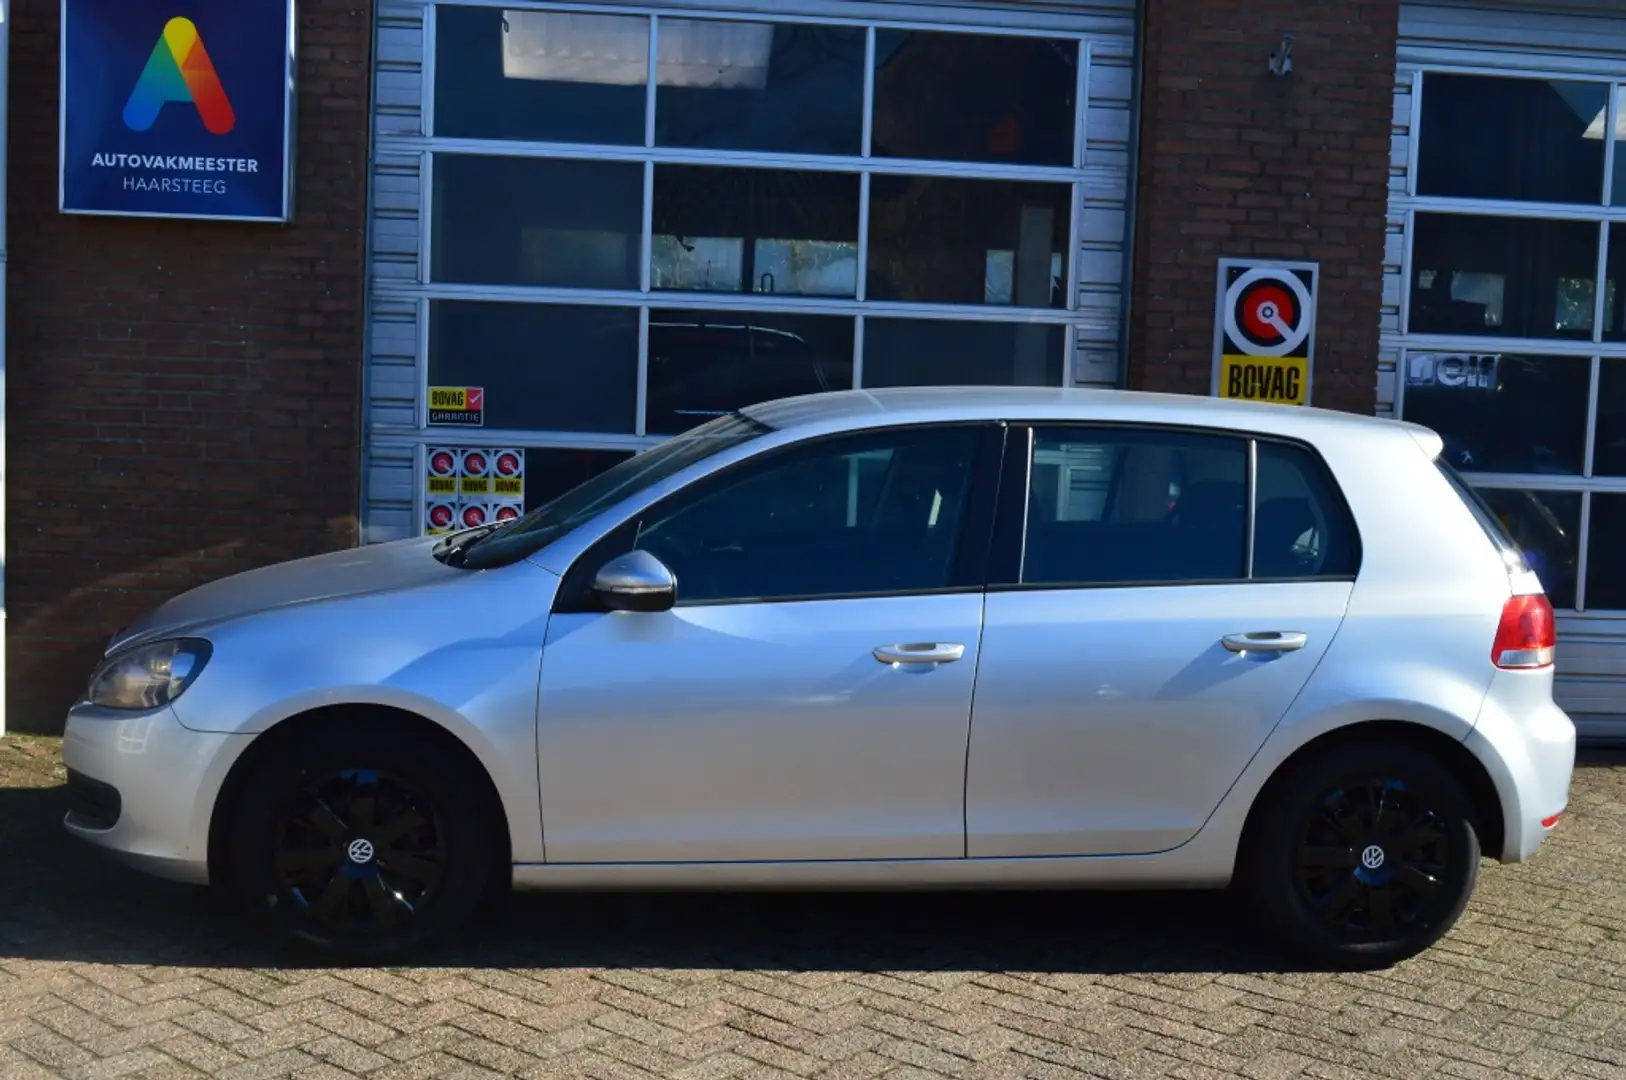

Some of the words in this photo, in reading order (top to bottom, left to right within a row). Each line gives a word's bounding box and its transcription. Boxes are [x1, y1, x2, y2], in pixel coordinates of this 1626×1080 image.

[91, 153, 259, 173] AUTOVAKMEESTER
[123, 176, 227, 194] HAARSTEEG
[1228, 364, 1300, 400] BOVAG
[432, 391, 464, 406] BOVAG
